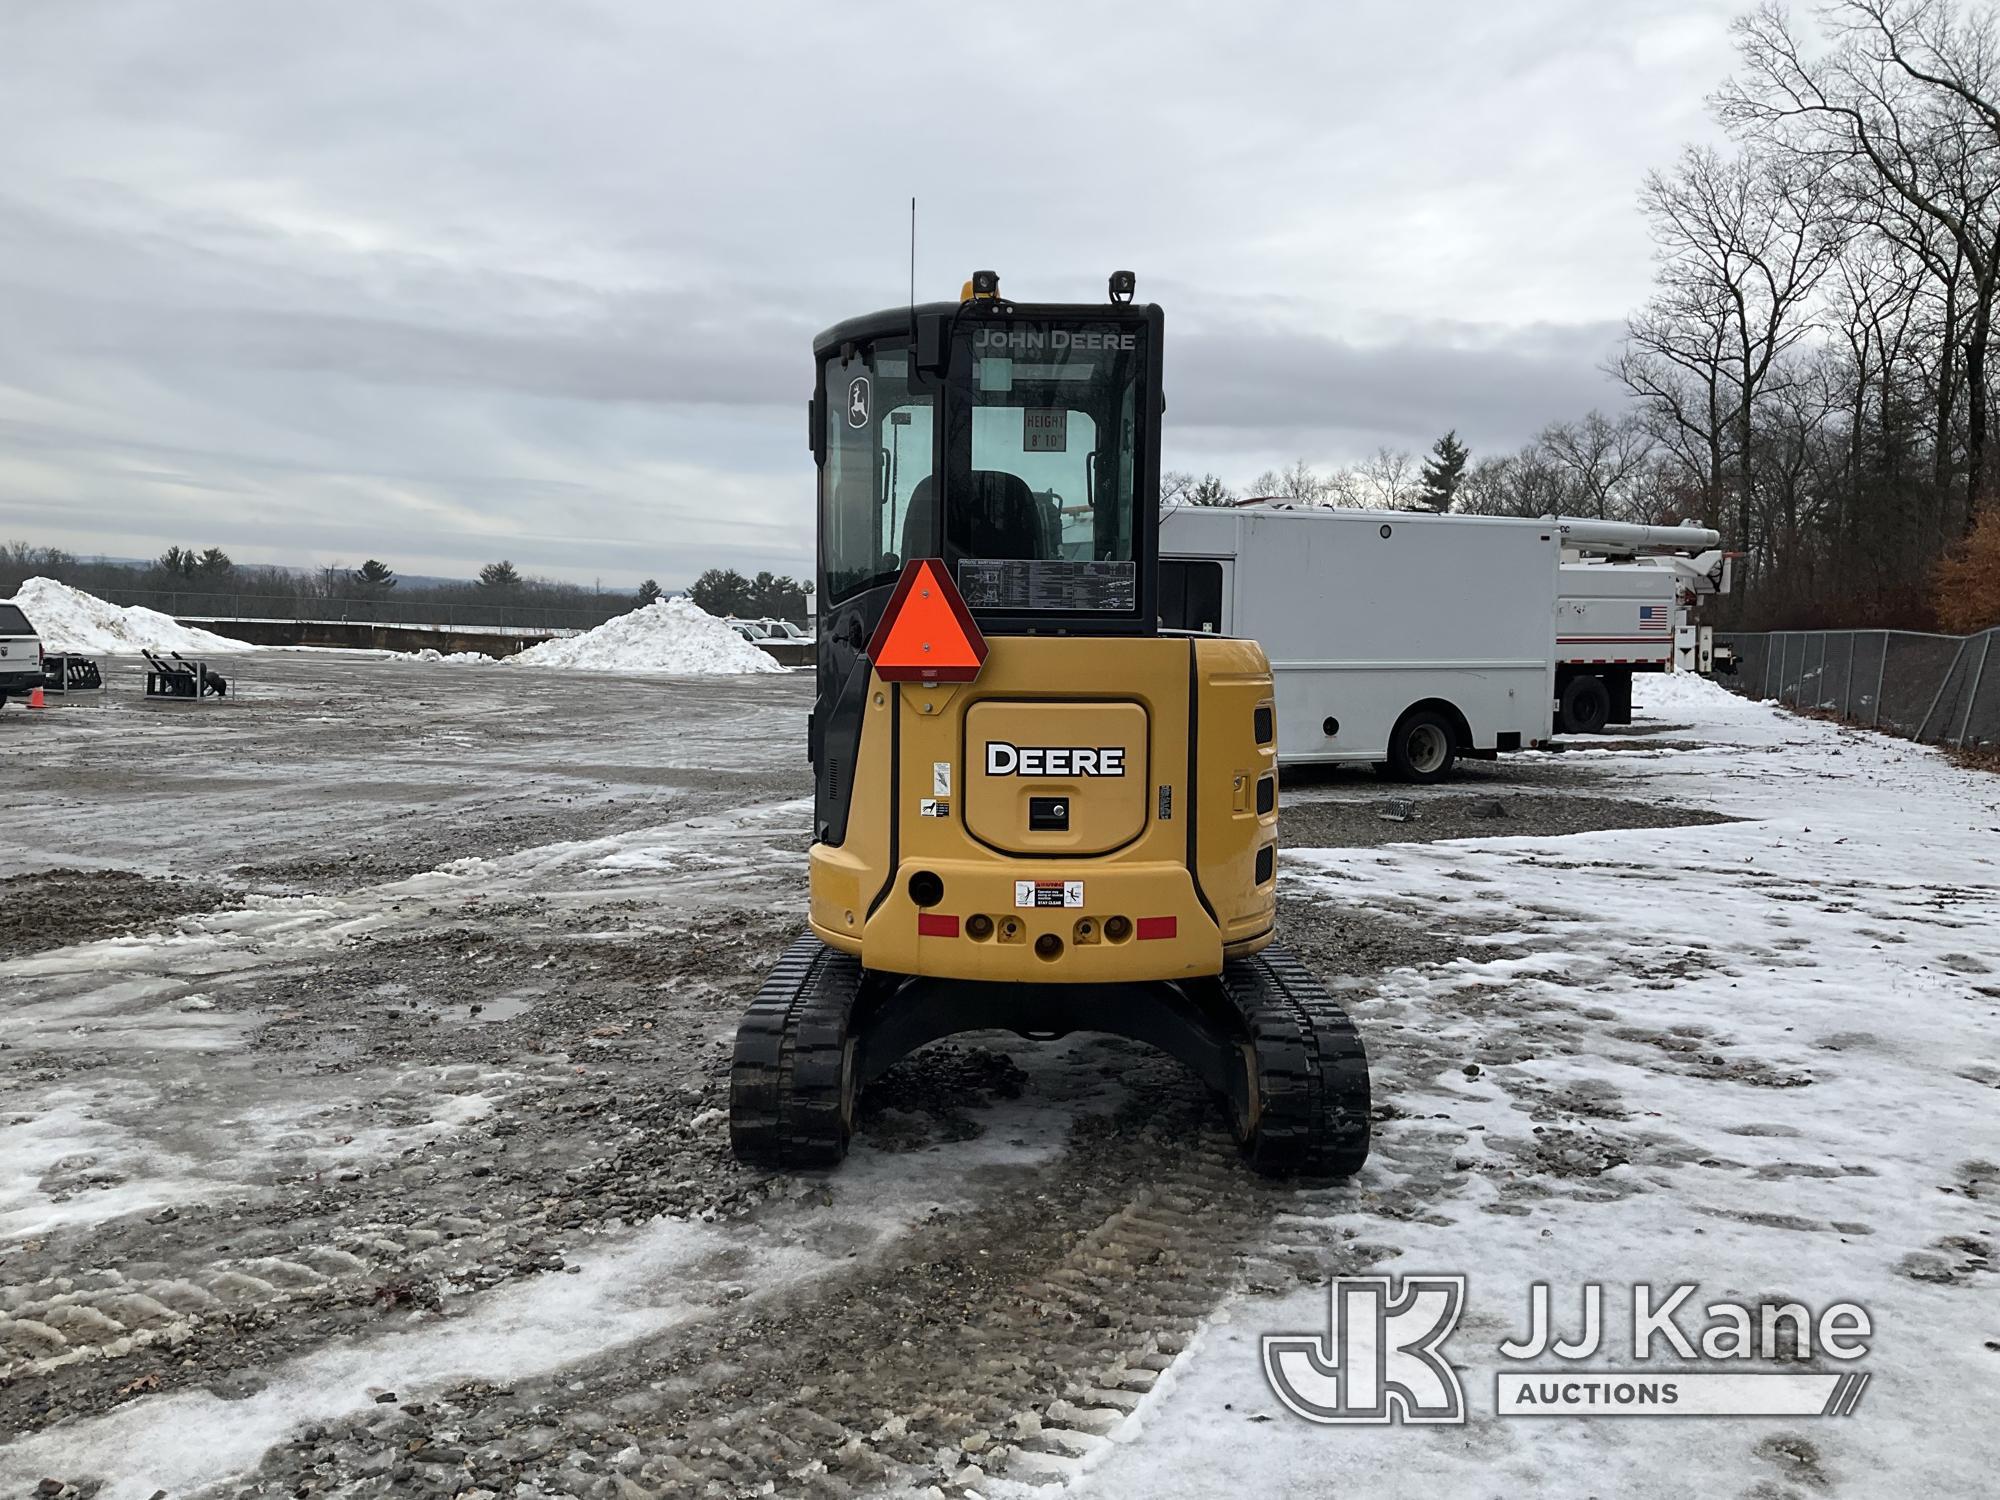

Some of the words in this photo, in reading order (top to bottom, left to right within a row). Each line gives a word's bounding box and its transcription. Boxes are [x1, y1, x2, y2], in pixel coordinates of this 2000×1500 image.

[975, 328, 1044, 349] JOHN
[1051, 330, 1136, 350] DEERE
[1027, 415, 1064, 428] HEIGHT
[987, 742, 1124, 775] DEERE
